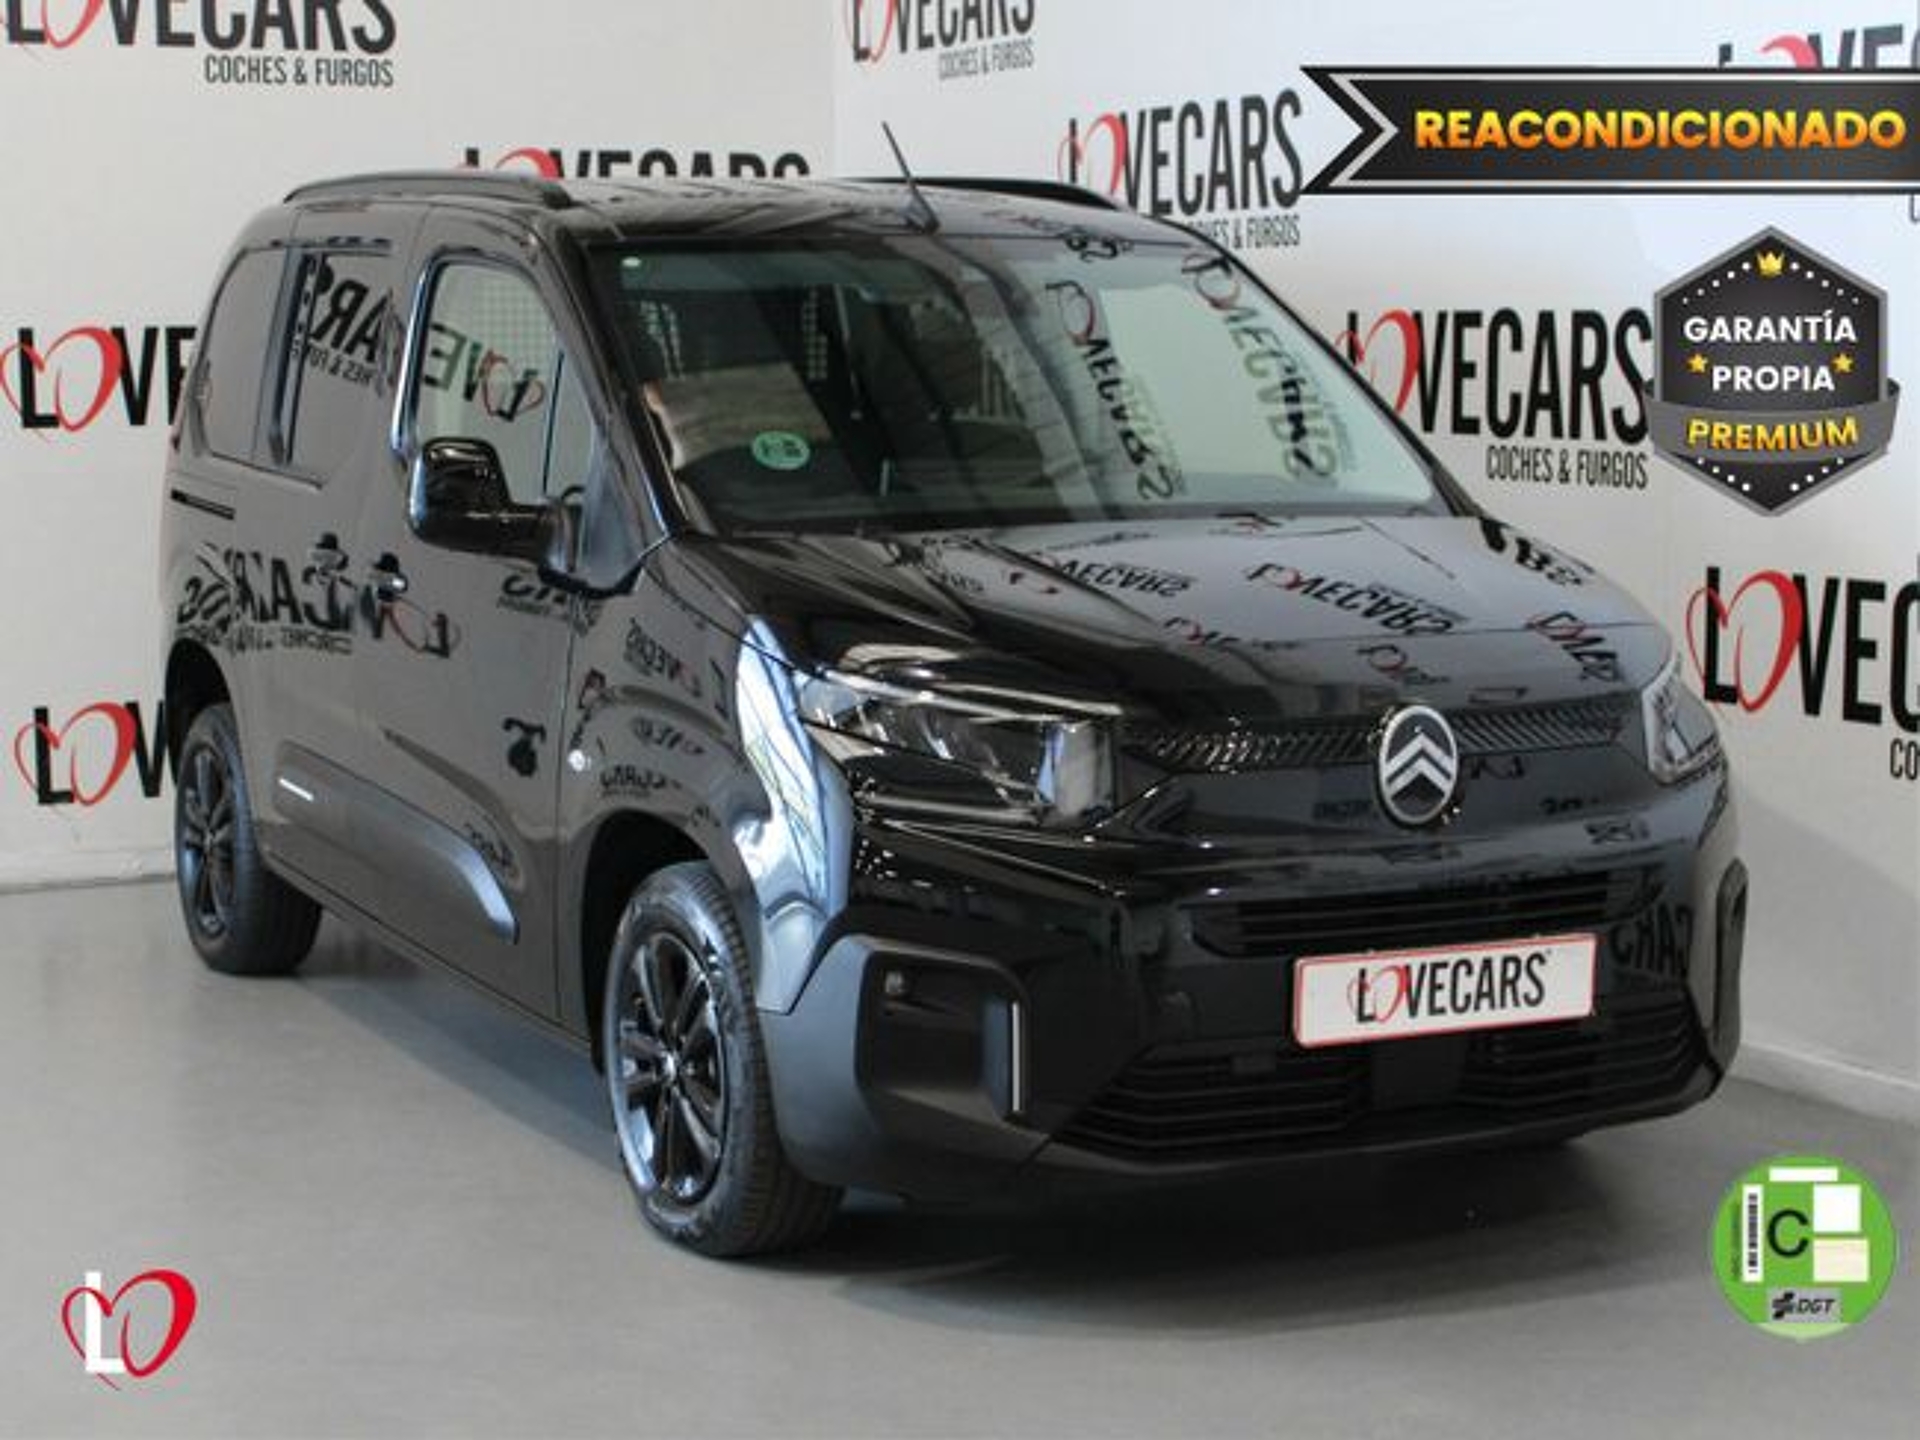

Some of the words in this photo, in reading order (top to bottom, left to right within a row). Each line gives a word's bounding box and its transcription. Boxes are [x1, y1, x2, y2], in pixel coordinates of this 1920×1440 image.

[204, 54, 287, 85] COCHES
[294, 57, 307, 85] &
[314, 58, 394, 87] FURGOS
[1486, 445, 1554, 483] COCHES
[1559, 449, 1571, 485] &
[1577, 449, 1648, 490] FURGOS
[1348, 951, 1546, 1024] LOVECARS
